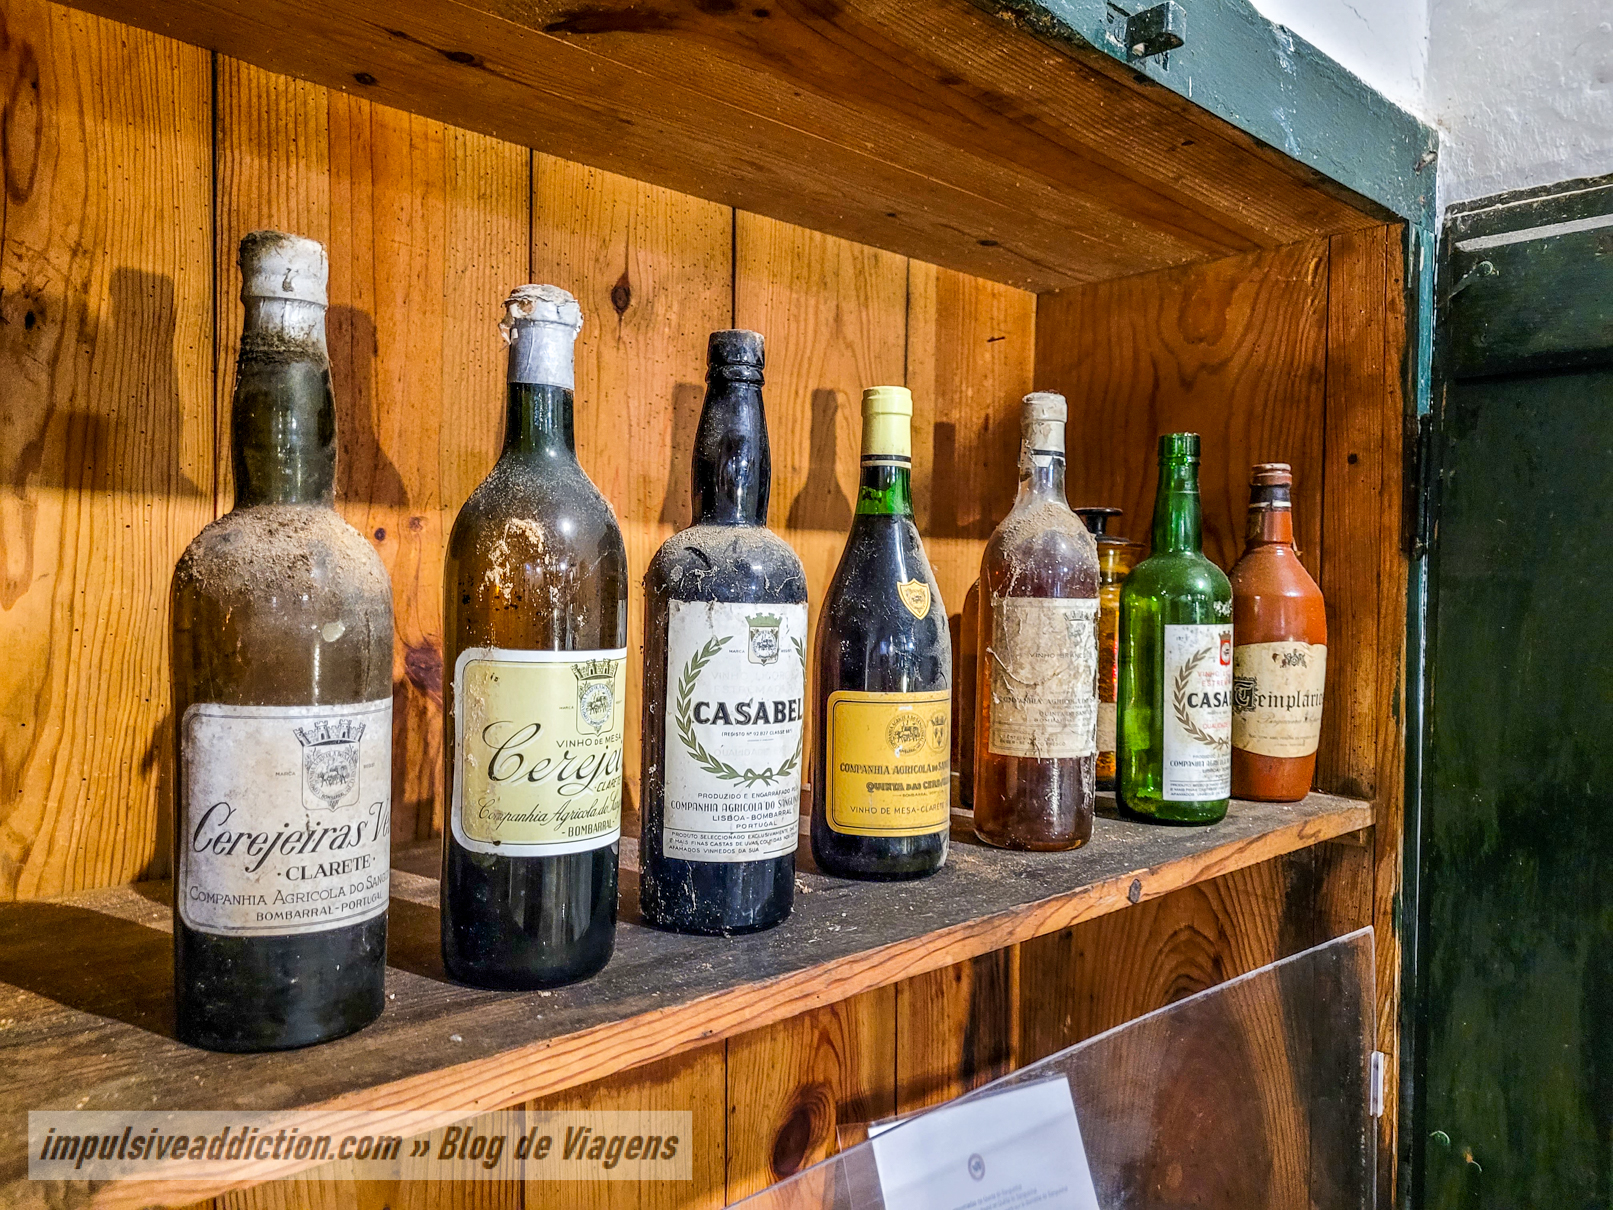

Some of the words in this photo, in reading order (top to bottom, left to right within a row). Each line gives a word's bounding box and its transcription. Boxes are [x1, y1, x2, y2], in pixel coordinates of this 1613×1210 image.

[1187, 690, 1232, 709] CASA
[556, 738, 592, 748] VINHO
[594, 737, 603, 746] DE
[840, 762, 891, 775] COMPANHIA
[891, 763, 931, 776] AGRICOLA
[697, 792, 742, 800] PRODUZIDO
[751, 788, 791, 799] ENGARRAFADO
[670, 800, 718, 812] COMPANHIA
[721, 801, 763, 813] AGRICOLA
[765, 800, 776, 811] DO
[850, 805, 878, 815] VINHO
[880, 805, 891, 815] DE
[567, 819, 612, 838] BOMBARRAL
[735, 821, 778, 830] PORTUGAL
[192, 801, 368, 874] Cerejeiras
[668, 844, 701, 854] AFAMADOS
[189, 885, 268, 906] COMPANHIA
[272, 886, 346, 905] AGRICOLA
[349, 881, 365, 895] DO
